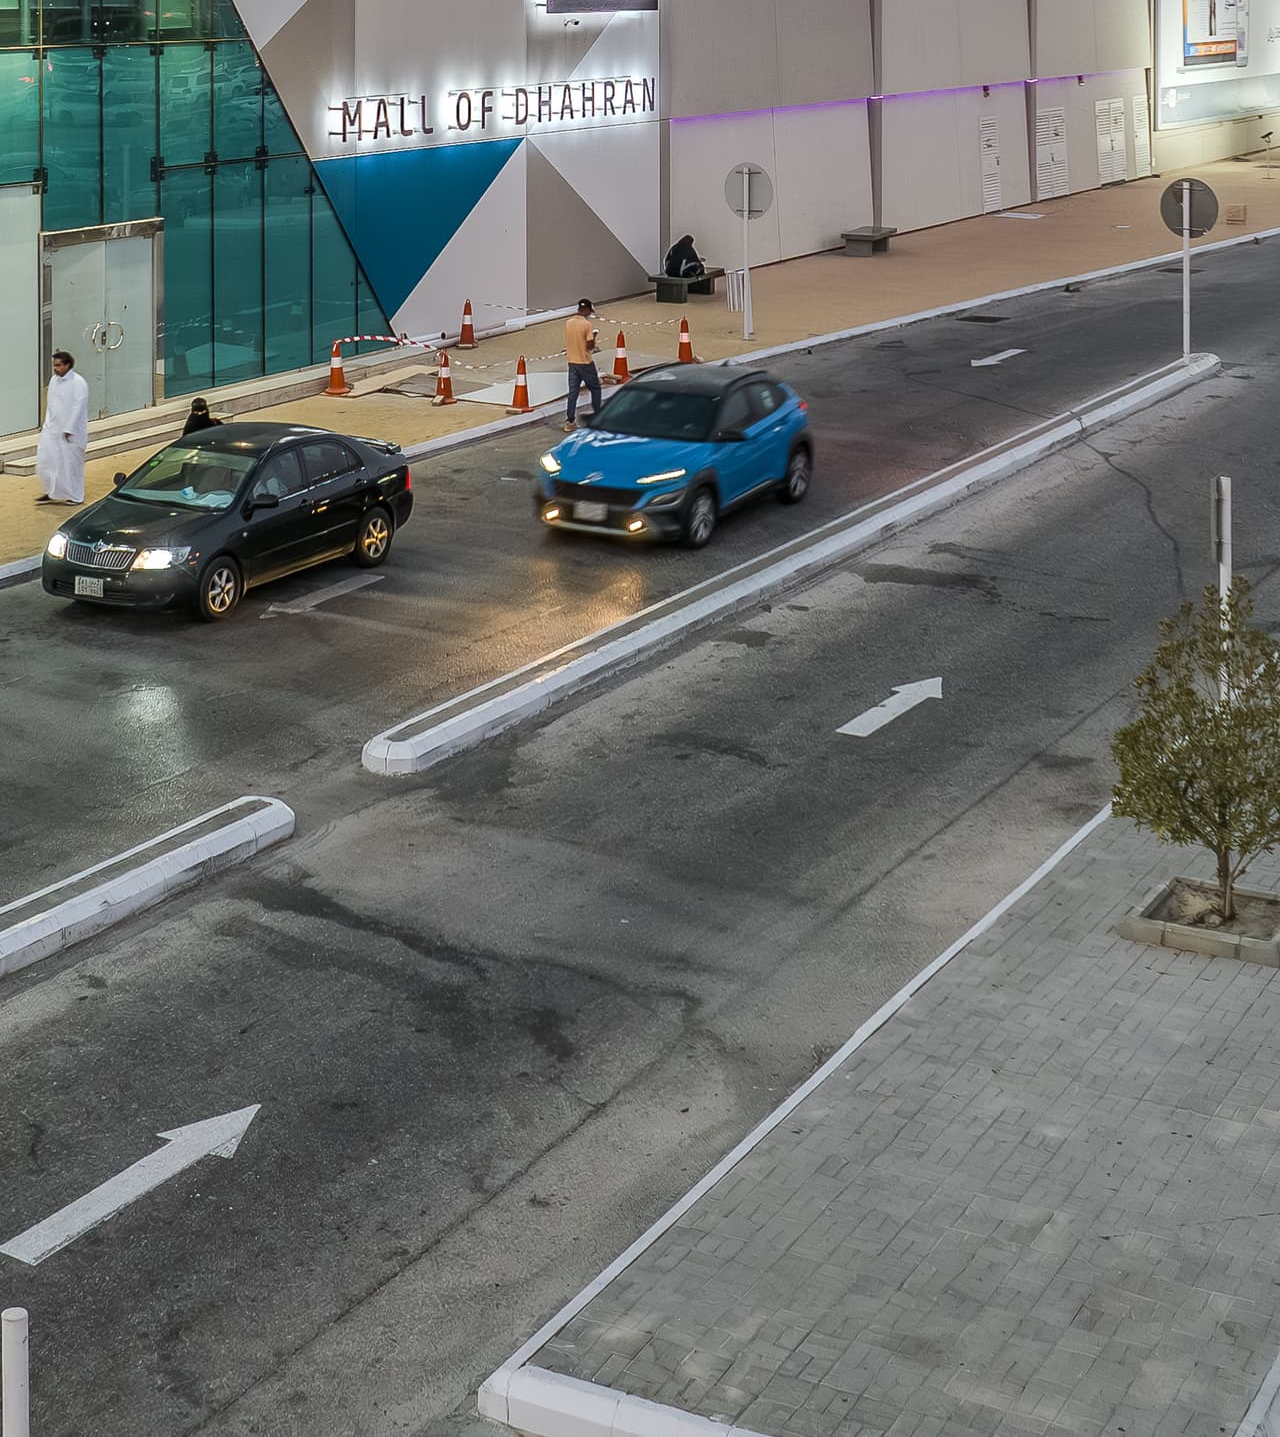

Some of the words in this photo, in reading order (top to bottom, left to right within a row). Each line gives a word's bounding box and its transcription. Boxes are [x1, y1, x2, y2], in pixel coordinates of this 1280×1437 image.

[342, 95, 433, 142] MALL
[456, 91, 493, 130] OF
[515, 77, 656, 125] DHAHRAN
